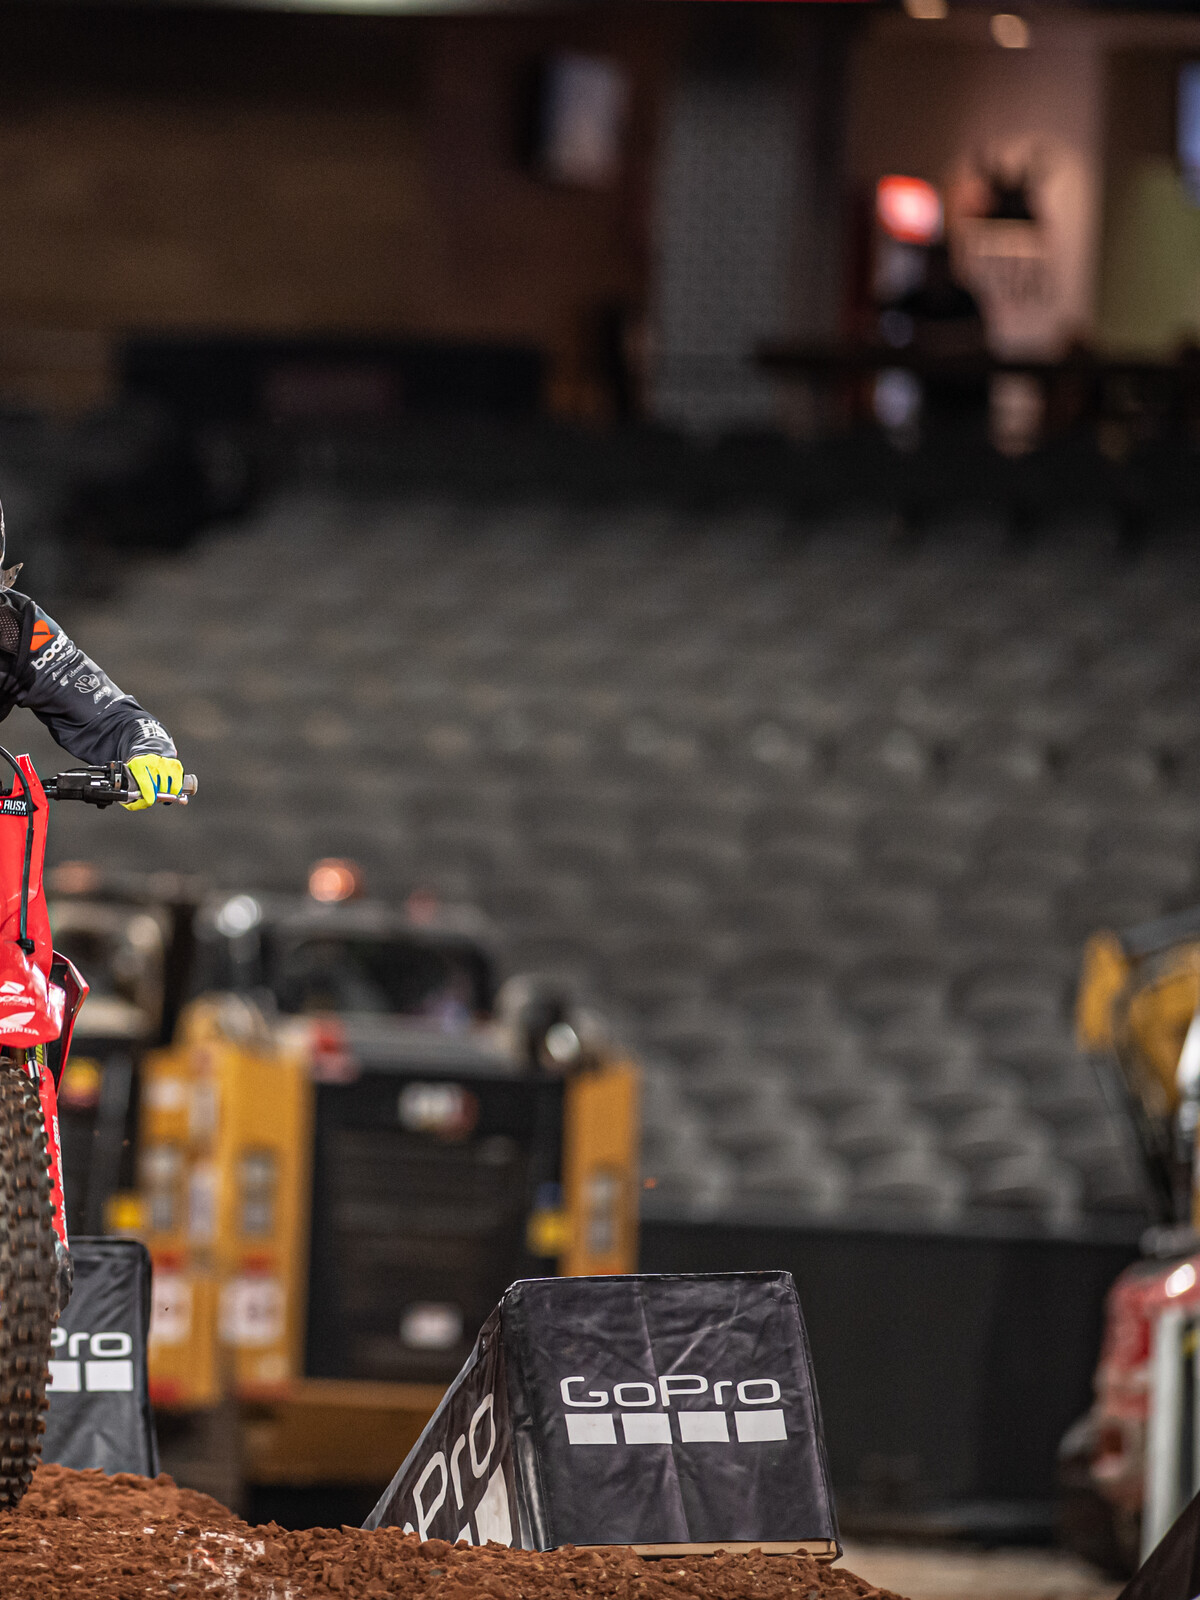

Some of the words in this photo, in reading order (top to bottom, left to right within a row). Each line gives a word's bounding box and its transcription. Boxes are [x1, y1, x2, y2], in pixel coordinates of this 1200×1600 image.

[50, 1326, 133, 1358] Pro
[559, 1374, 782, 1408] GoPro
[403, 1393, 496, 1543] Pro
